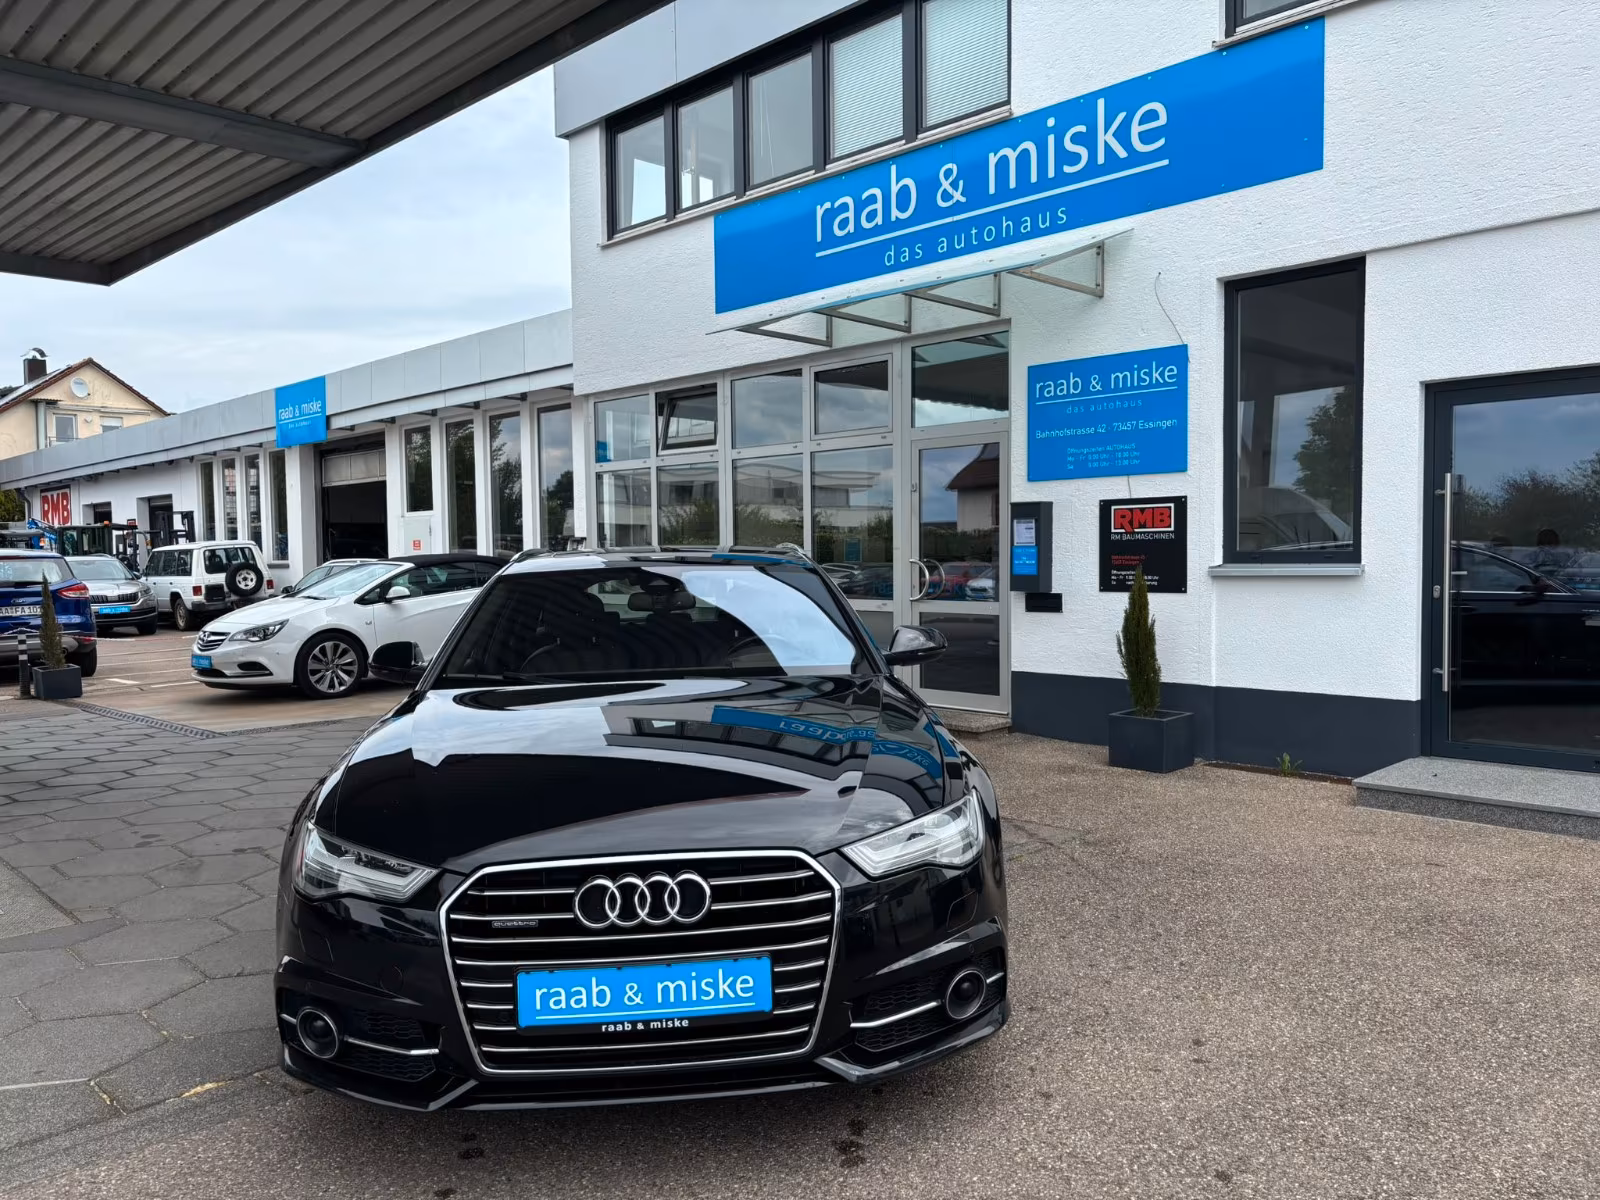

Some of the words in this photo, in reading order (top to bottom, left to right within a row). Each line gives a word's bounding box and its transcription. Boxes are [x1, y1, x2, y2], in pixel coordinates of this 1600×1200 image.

[816, 164, 918, 242] raab
[936, 162, 966, 208] &
[988, 98, 1168, 196] miske
[884, 240, 923, 266] das
[938, 206, 1068, 254] autohaus
[1036, 372, 1082, 398] raab
[1090, 374, 1102, 392] &
[1110, 361, 1178, 388] miske
[278, 403, 294, 420] raab
[294, 405, 300, 416] &
[300, 397, 322, 415] miske
[1066, 405, 1084, 414] das
[1090, 400, 1143, 412] autohaus
[1036, 426, 1095, 439] Bahnhofstrasse
[1096, 424, 1106, 433] 42
[1113, 421, 1137, 431] 73457
[1138, 419, 1178, 430] Essingen
[42, 492, 70, 526] RMB
[1114, 507, 1172, 532] RMB
[1122, 532, 1175, 540] BAUMASCHINEN
[535, 976, 611, 1010] raab
[624, 982, 644, 1005] &
[657, 968, 755, 1003] miske
[602, 1020, 632, 1032] raab
[650, 1018, 689, 1029] miske
